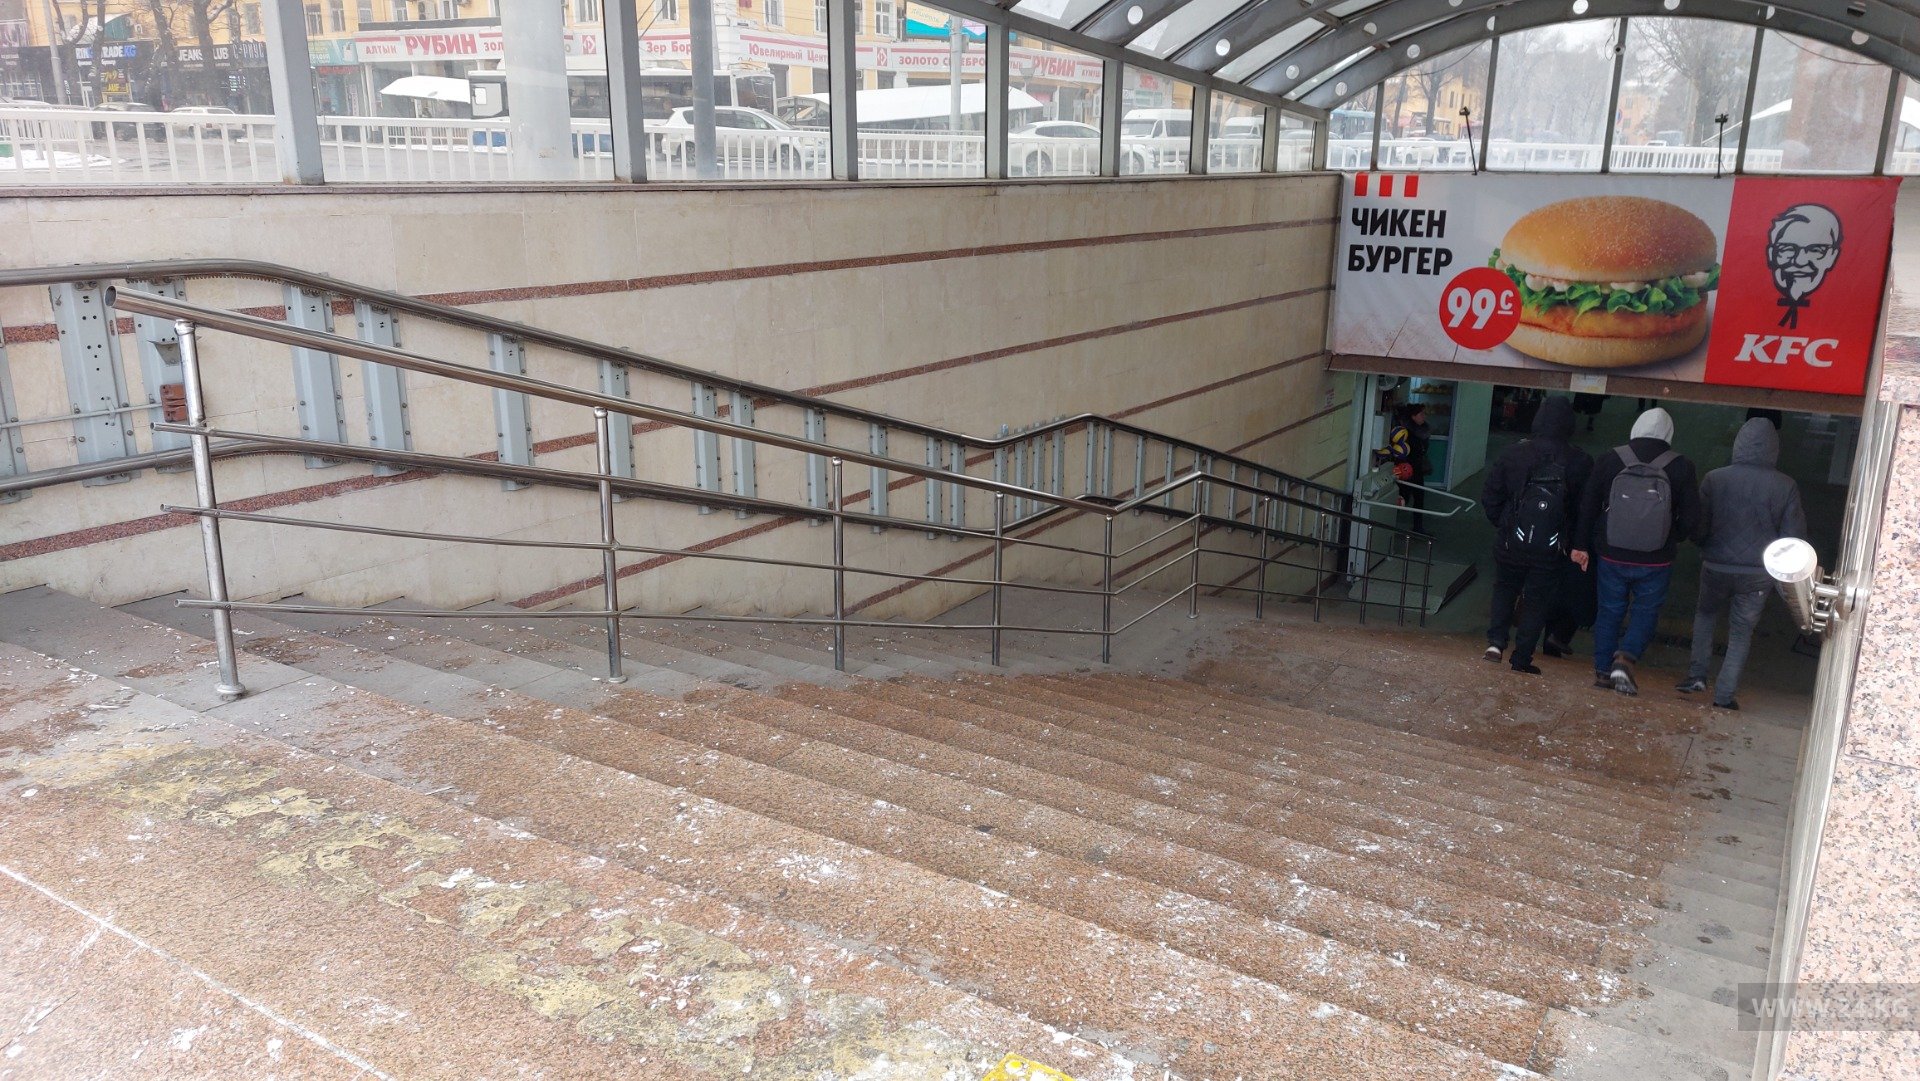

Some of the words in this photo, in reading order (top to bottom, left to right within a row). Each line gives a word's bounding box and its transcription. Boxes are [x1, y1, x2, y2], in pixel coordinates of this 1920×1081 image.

[212, 47, 229, 60] LUB
[232, 42, 265, 60] СРИУС
[365, 46, 397, 55] АЛТЫН
[404, 34, 478, 56] РУБИН
[484, 42, 504, 52] ЗОЛ
[646, 41, 667, 54] Зер
[748, 43, 803, 60] Ювелирный
[807, 50, 828, 63] Цент
[899, 56, 939, 66] ЗОЛОТО
[1032, 55, 1076, 77] РУБИН
[1352, 208, 1447, 238] ЧИКЕН
[1348, 244, 1453, 275] БУРГЕР
[1733, 333, 1839, 368] KFC
